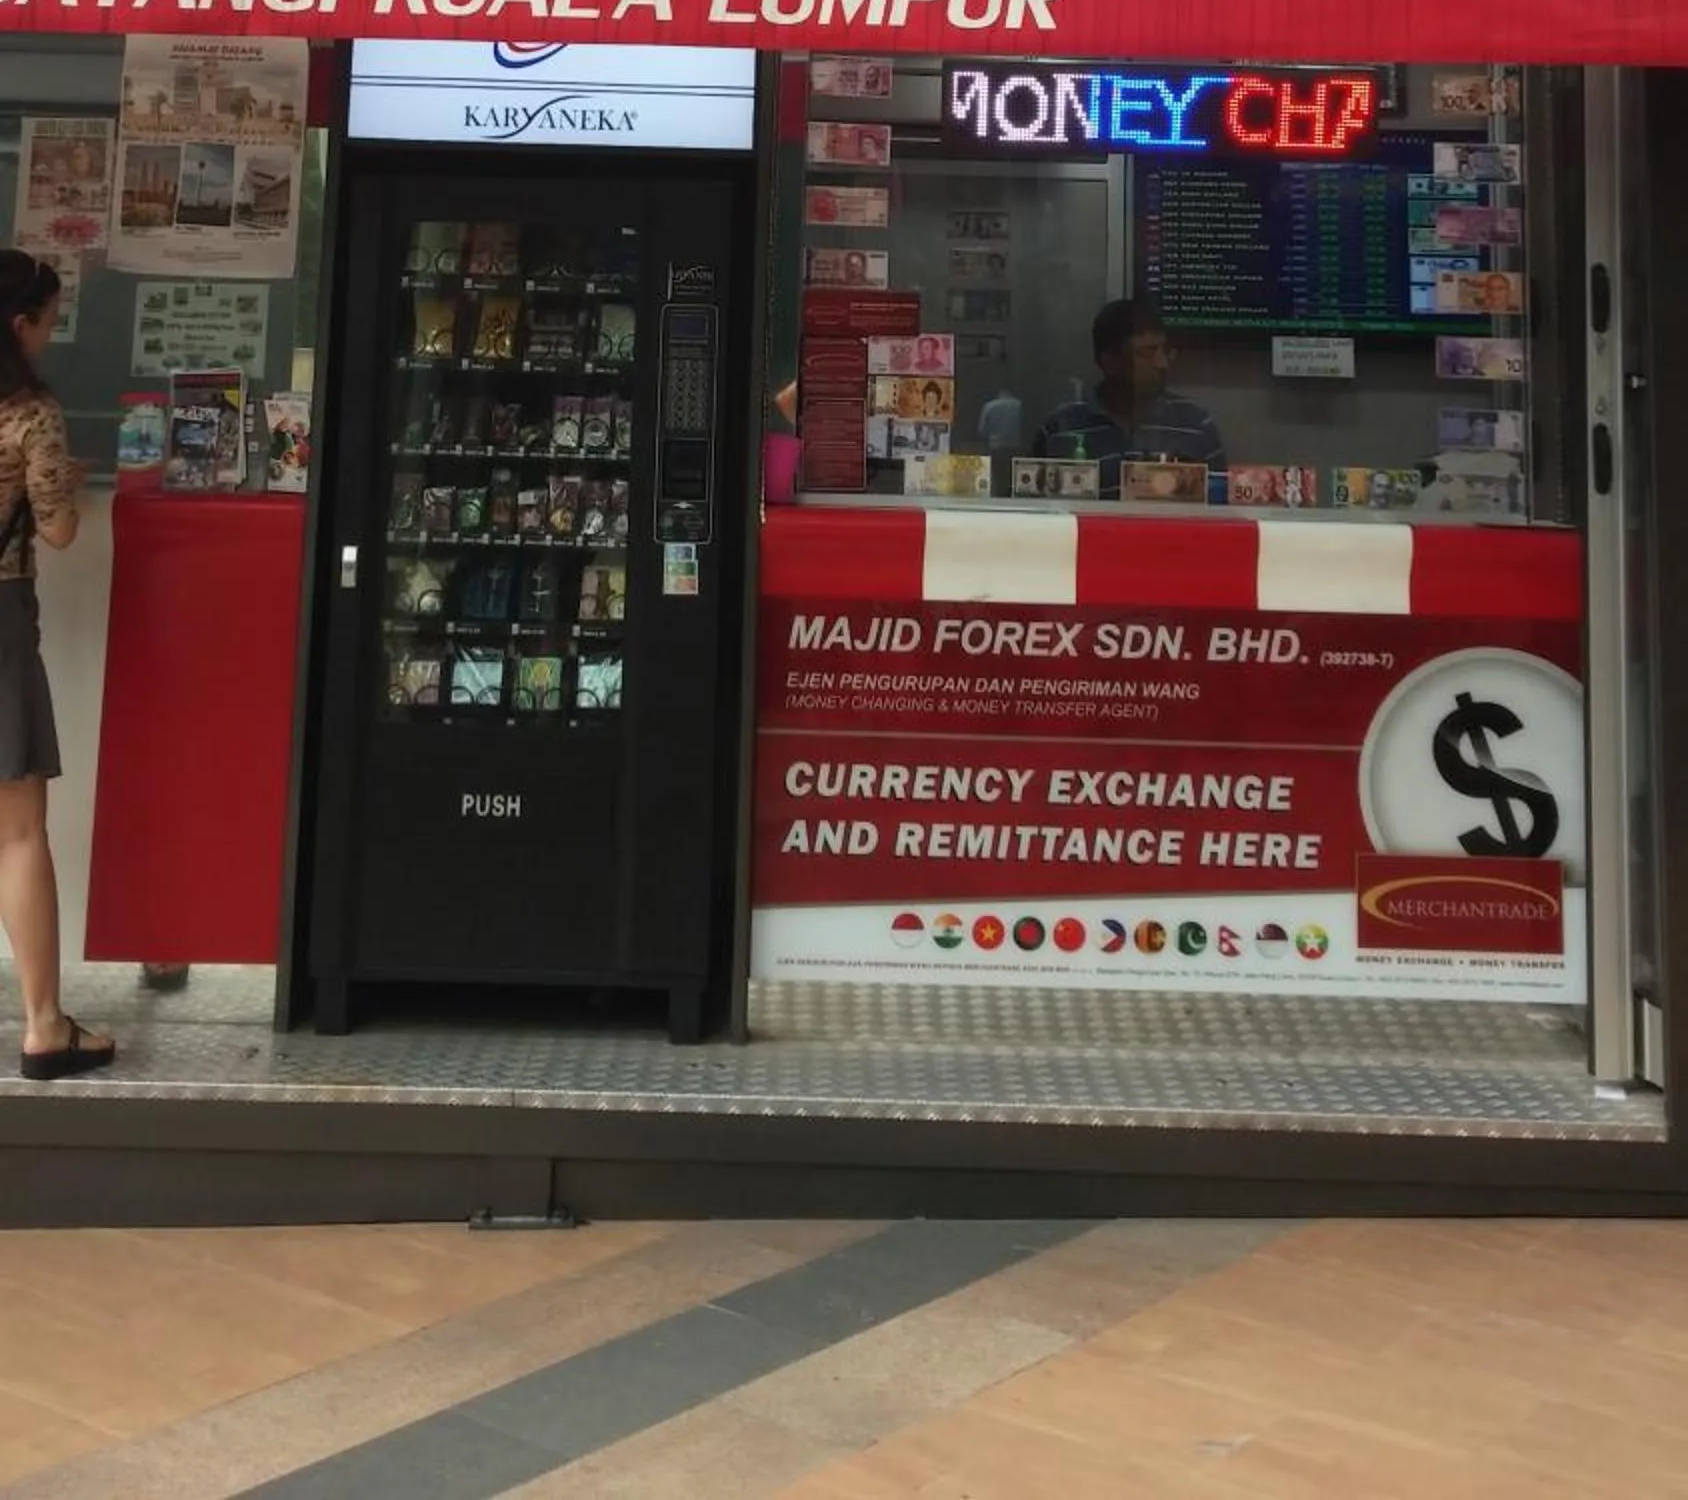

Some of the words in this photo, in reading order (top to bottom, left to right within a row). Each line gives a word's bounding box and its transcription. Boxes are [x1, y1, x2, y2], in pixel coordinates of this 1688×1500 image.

[788, 614, 922, 652] MAJID
[933, 619, 1084, 658] FOREX
[1093, 623, 1192, 661] SDN.
[1207, 626, 1309, 665] BHD.
[785, 671, 835, 689] EJEN
[839, 673, 970, 694] PENGURUPAN
[975, 678, 1015, 695] DAN
[1019, 678, 1138, 698] PENGIRIMAN
[1142, 683, 1201, 700] WANG
[953, 700, 1009, 715] MONEY
[1015, 700, 1096, 717] TRANSFER
[785, 760, 1036, 803] CURRENCY
[1048, 769, 1295, 811] EXCHANGE
[461, 794, 522, 818] PUSH
[781, 819, 880, 856] AND
[895, 821, 1185, 866] REMITTANCE
[1199, 831, 1322, 869] HERE
[1387, 898, 1549, 921] MERCHANTRADE
